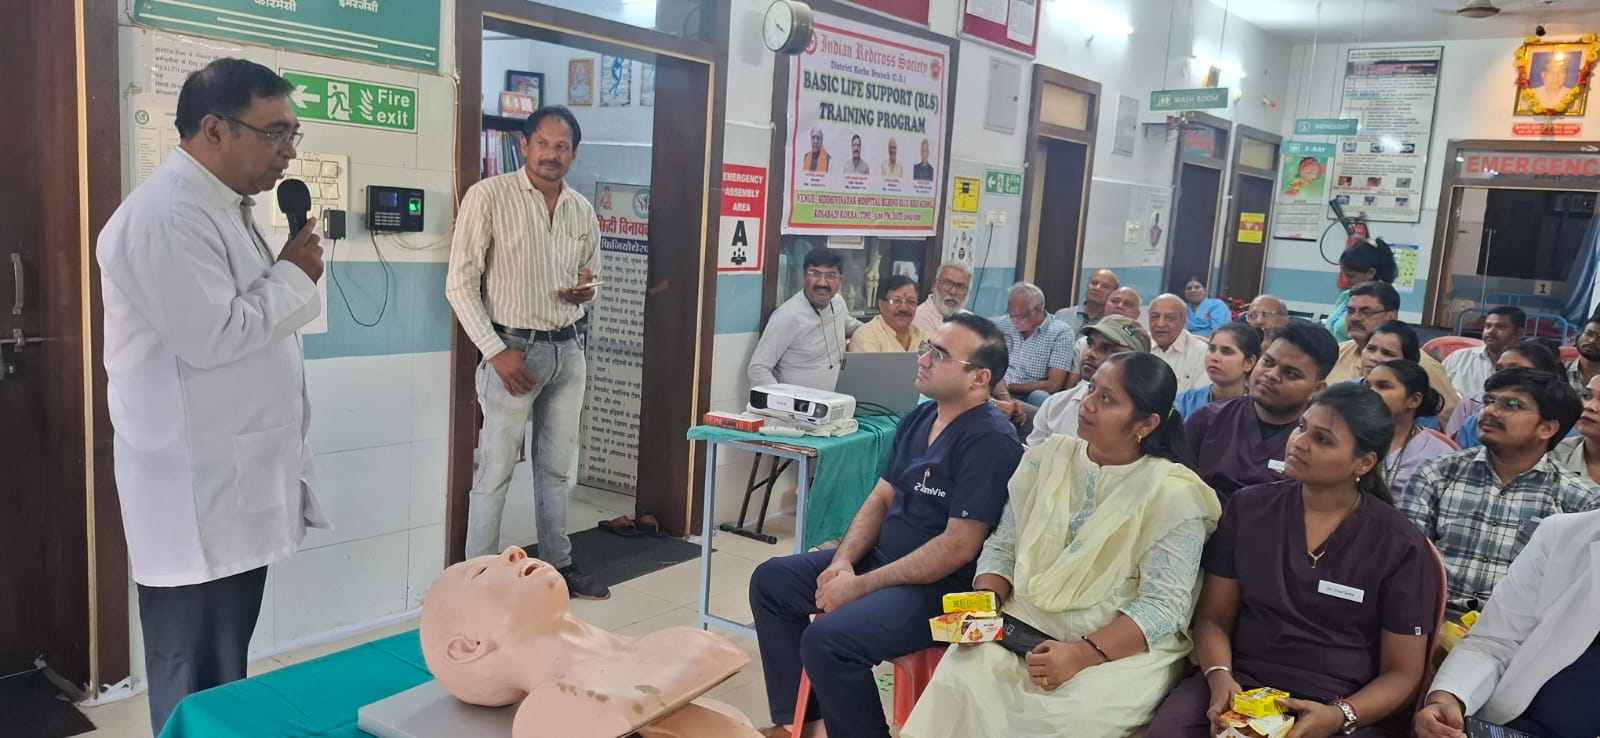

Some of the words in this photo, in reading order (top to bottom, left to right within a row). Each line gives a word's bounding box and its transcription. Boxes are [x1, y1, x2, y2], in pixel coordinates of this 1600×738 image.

[820, 34, 853, 59] Indian
[855, 42, 896, 67] Redcross
[898, 53, 928, 74] Society
[830, 60, 853, 72] District
[377, 88, 410, 107] Fire
[803, 70, 839, 93] BASIC
[840, 77, 864, 98] LIFE
[865, 82, 913, 107] SUPPORT
[914, 91, 939, 114] (BLS)
[1174, 95, 1196, 104] WASH
[1196, 94, 1219, 103] ROOM
[376, 110, 408, 126] exit
[819, 102, 874, 126] TRAINING
[877, 111, 926, 133] PROGRAM
[722, 172, 763, 184] EMERGENCY
[725, 187, 760, 198] ASSEMBLY
[732, 202, 751, 212] AREA
[731, 220, 748, 246] A
[1539, 284, 1547, 293] 1
